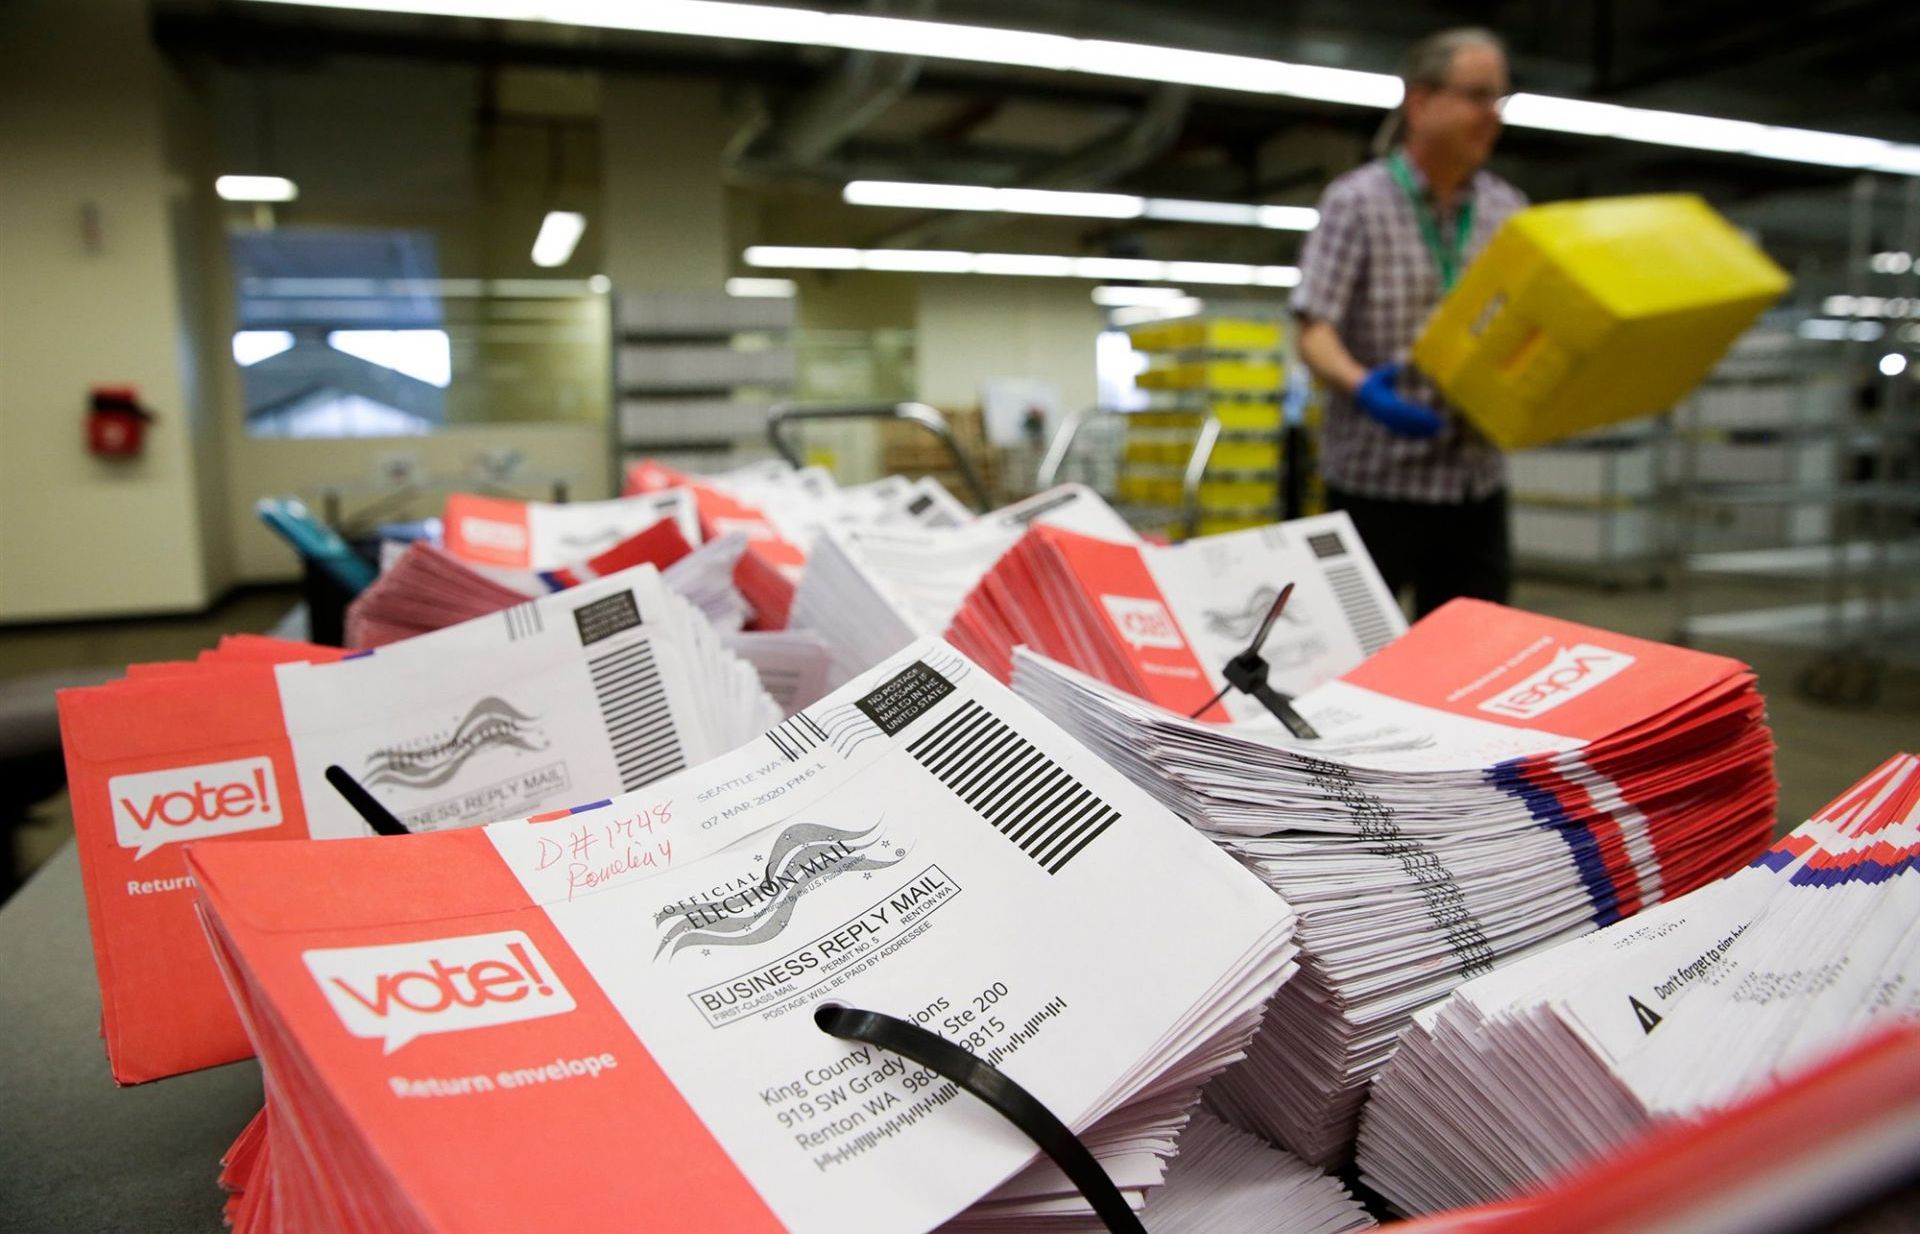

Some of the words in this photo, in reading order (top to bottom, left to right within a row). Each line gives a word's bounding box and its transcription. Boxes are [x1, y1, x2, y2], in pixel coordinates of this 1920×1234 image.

[867, 693, 883, 706] NO
[881, 668, 918, 696] POSTAGE
[874, 679, 920, 714] NECESSARY
[879, 697, 912, 722] MAILED
[910, 690, 922, 701] IN
[920, 677, 939, 693] THE
[886, 706, 919, 730] UNITED
[917, 684, 948, 708] STATES
[120, 767, 274, 829] vote!
[463, 784, 519, 810] REPLY
[523, 768, 563, 790] MAIL
[697, 772, 755, 803] SEATTLE
[756, 760, 781, 777] WA
[701, 815, 719, 830] 07
[721, 801, 752, 820] MAR
[752, 786, 786, 806] 2020
[127, 875, 197, 896] Return
[662, 872, 760, 916] OFFICIAL
[685, 868, 799, 930] ELECTION
[798, 840, 857, 879] MAIL
[808, 880, 822, 891] U.S.
[699, 951, 819, 1012] BUSINESS
[817, 906, 892, 959] REPLY
[889, 873, 945, 915] MAIL
[713, 991, 773, 1023] FIRST-CLASS
[772, 982, 799, 998] MAIL
[819, 951, 855, 974] PERMIT
[852, 942, 874, 959] NO.
[871, 936, 880, 946] 5
[899, 898, 937, 926] RENTON
[934, 886, 953, 904] WA
[329, 942, 554, 1018] vote!
[762, 996, 810, 1021] POSTAGE
[808, 983, 834, 1001] WILL
[831, 975, 847, 991] BE
[845, 963, 868, 981] PAID
[864, 954, 880, 970] BY
[880, 920, 933, 960] ADDRESSEE
[1653, 975, 1684, 1000] Don't
[1677, 955, 1711, 978] forget
[1705, 949, 1721, 963] to
[387, 1072, 496, 1099] Return
[496, 1051, 618, 1089] envelope
[759, 1081, 808, 1107] King
[805, 1046, 873, 1087] County
[777, 1102, 816, 1129] 919
[815, 1086, 848, 1112] SW
[848, 1056, 906, 1095] Grady
[943, 1009, 976, 1034] Ste
[972, 981, 1008, 1013] 200
[795, 1110, 867, 1151] Renton
[863, 1091, 902, 1116] WA
